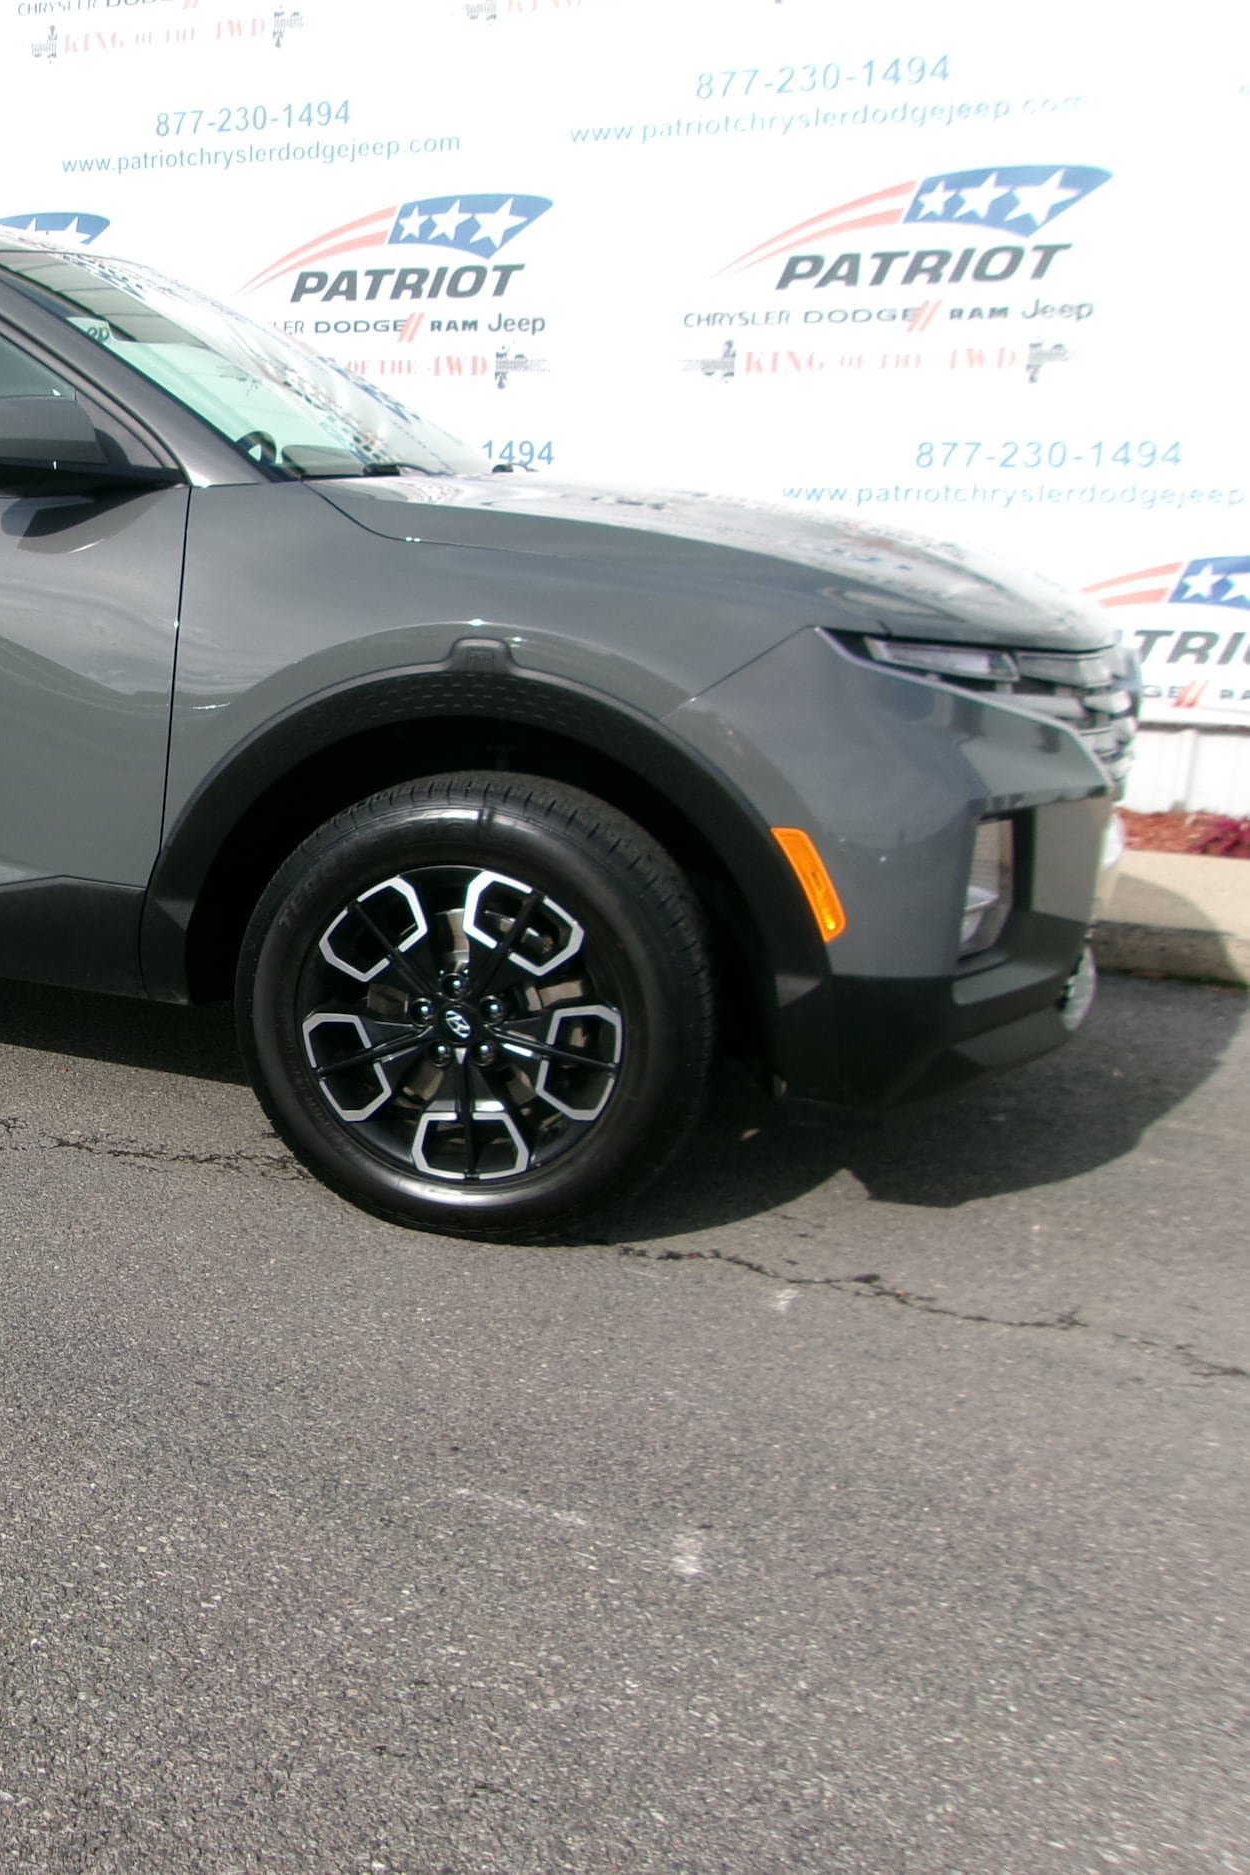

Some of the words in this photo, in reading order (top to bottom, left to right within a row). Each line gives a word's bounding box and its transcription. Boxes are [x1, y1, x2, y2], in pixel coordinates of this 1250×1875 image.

[692, 53, 952, 101] 877-230-1494
[154, 99, 352, 138] 877-230-1494
[568, 94, 1089, 145] www.patriotchryslerdodgejeepcom
[61, 134, 462, 175] www.patriotchryslerdodgejeep.com
[290, 262, 526, 304] PATRIOT
[774, 242, 1074, 292] PATRIOT
[313, 318, 408, 335] DODGE
[429, 318, 479, 334] RAM
[487, 312, 547, 337] Jeep
[682, 308, 792, 328] CHRYSLER
[801, 306, 921, 326] DODGE
[948, 304, 1009, 322] RAM
[1020, 298, 1095, 324] Jeep
[914, 438, 1184, 470] 877-230-1494
